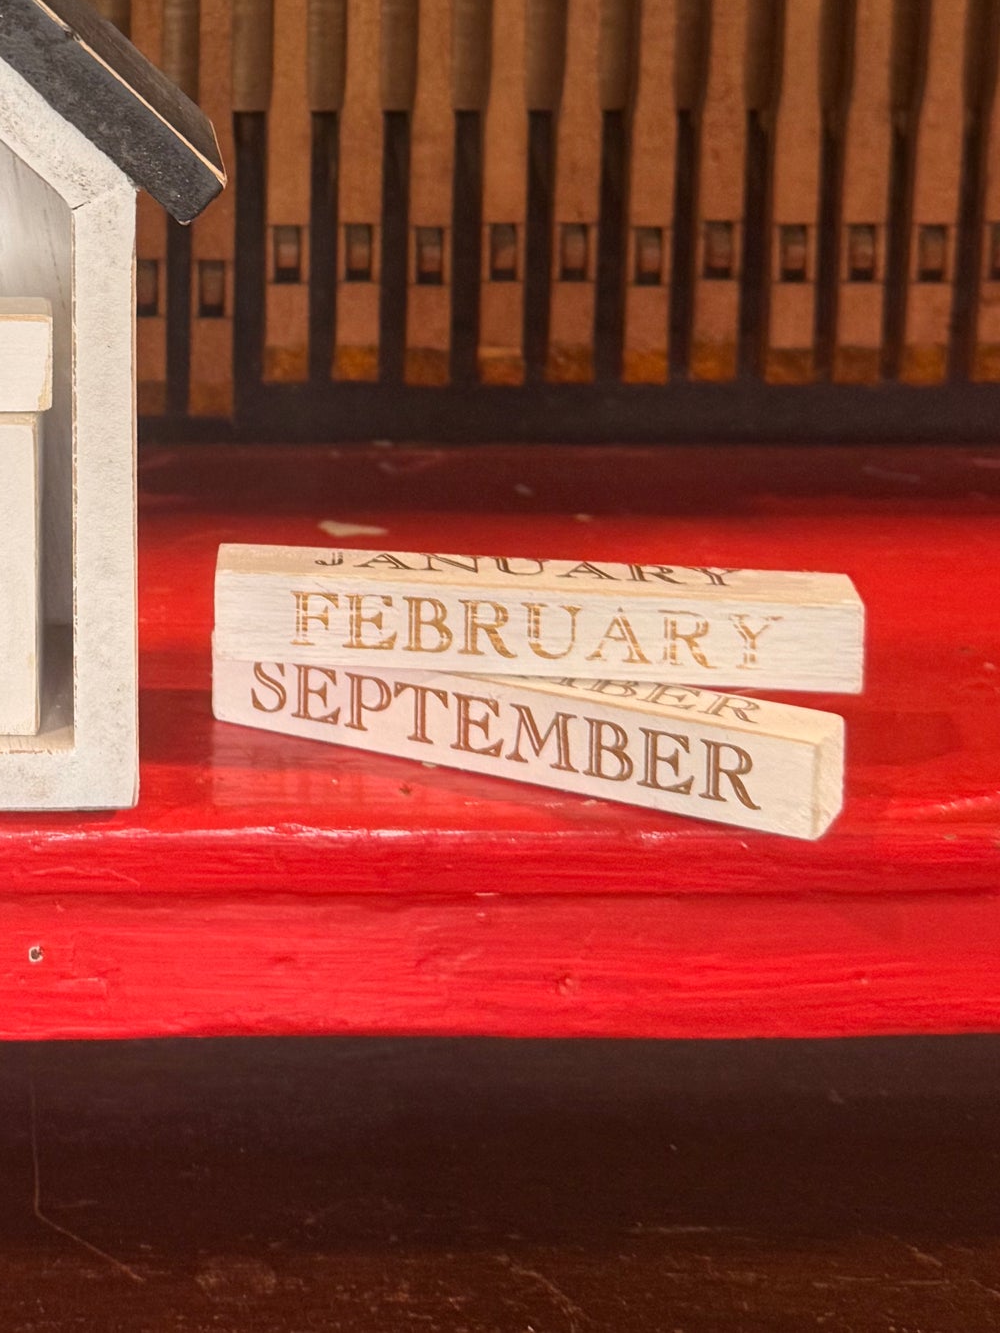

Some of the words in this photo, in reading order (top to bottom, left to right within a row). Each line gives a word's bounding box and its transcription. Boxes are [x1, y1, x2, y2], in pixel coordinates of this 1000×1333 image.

[314, 550, 743, 587] JANUARY
[289, 590, 783, 670] FEBRUARY
[250, 659, 763, 811] SEPTEMBER
